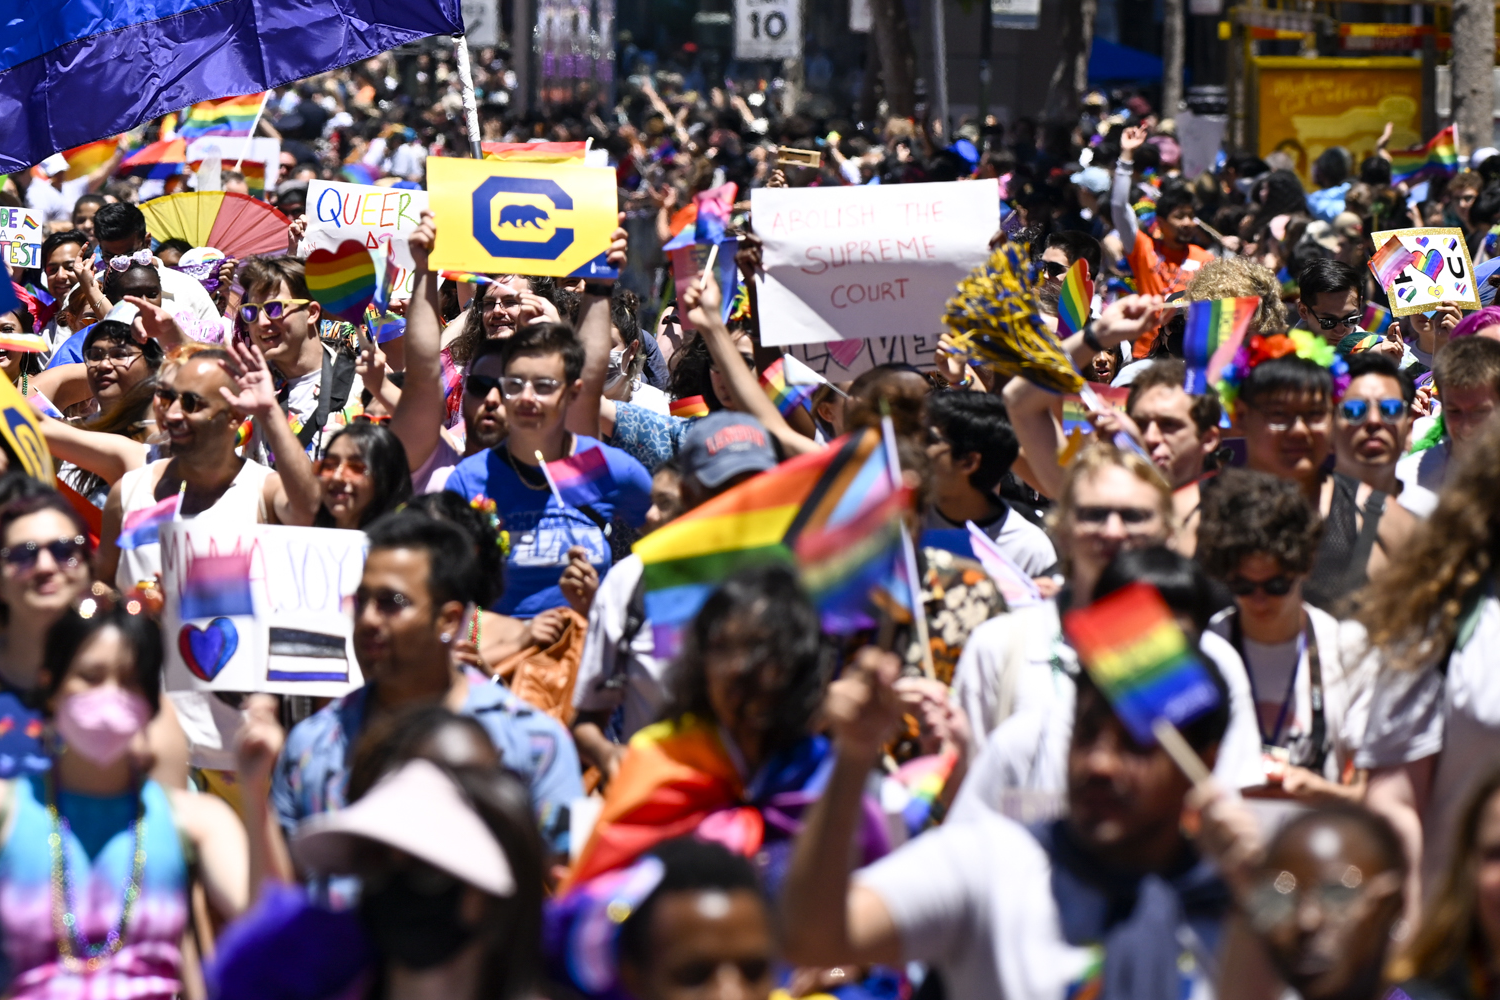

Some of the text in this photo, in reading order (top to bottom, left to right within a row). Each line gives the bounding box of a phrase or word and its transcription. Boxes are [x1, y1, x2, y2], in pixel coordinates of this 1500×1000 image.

[748, 11, 788, 40] 10
[317, 187, 420, 231] QUEER
[771, 201, 944, 236] ABOLISH THE
[0, 230, 7, 240] A
[801, 235, 936, 275] SUPREME
[1446, 256, 1465, 279] U
[831, 278, 910, 309] COURT
